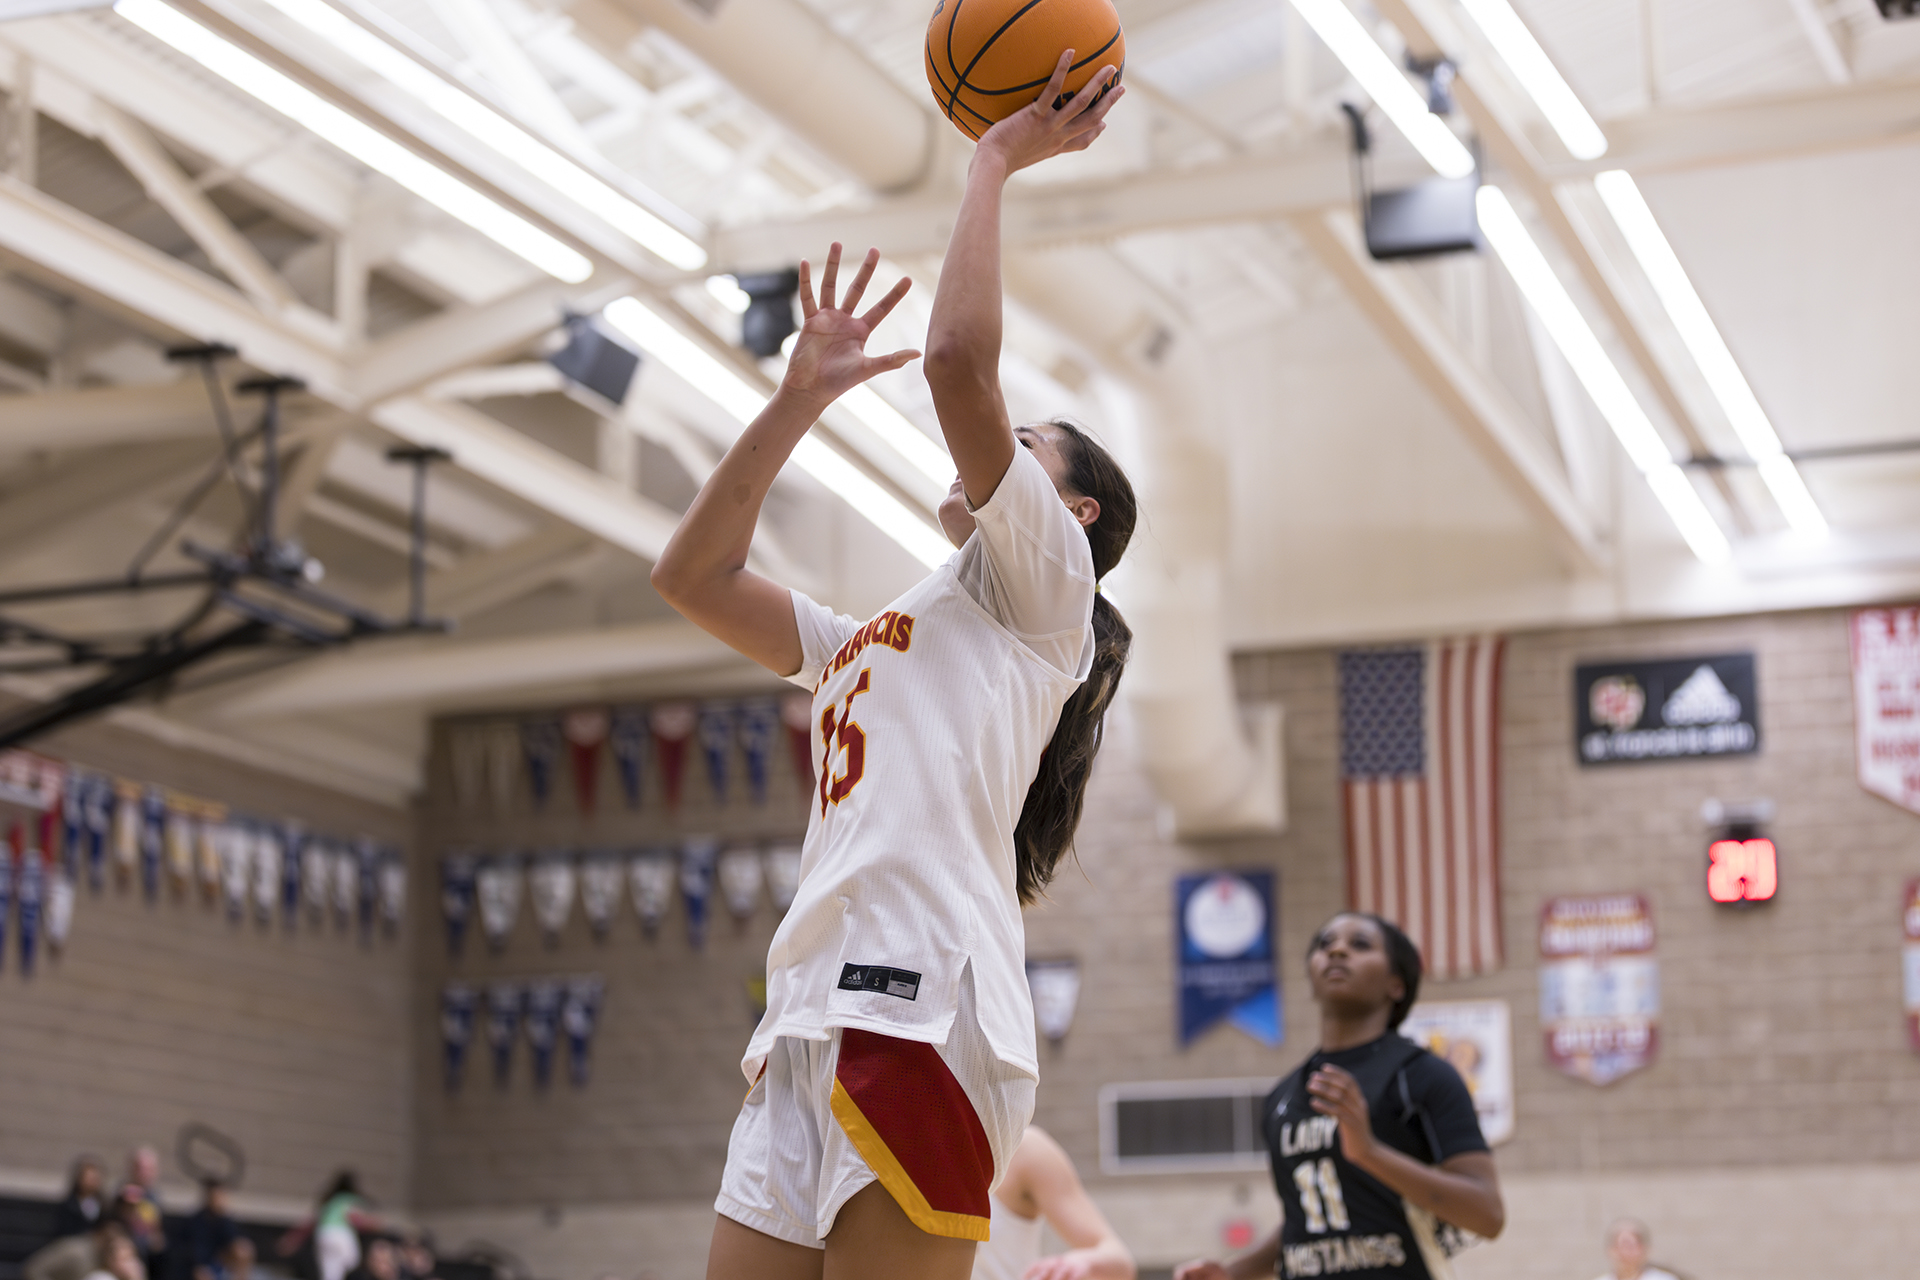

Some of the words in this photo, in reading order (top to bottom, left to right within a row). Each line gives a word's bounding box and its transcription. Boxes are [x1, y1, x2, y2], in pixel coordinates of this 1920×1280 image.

[820, 667, 871, 822] 15
[1280, 1115, 1339, 1158] LADY
[1293, 1158, 1351, 1234] 11
